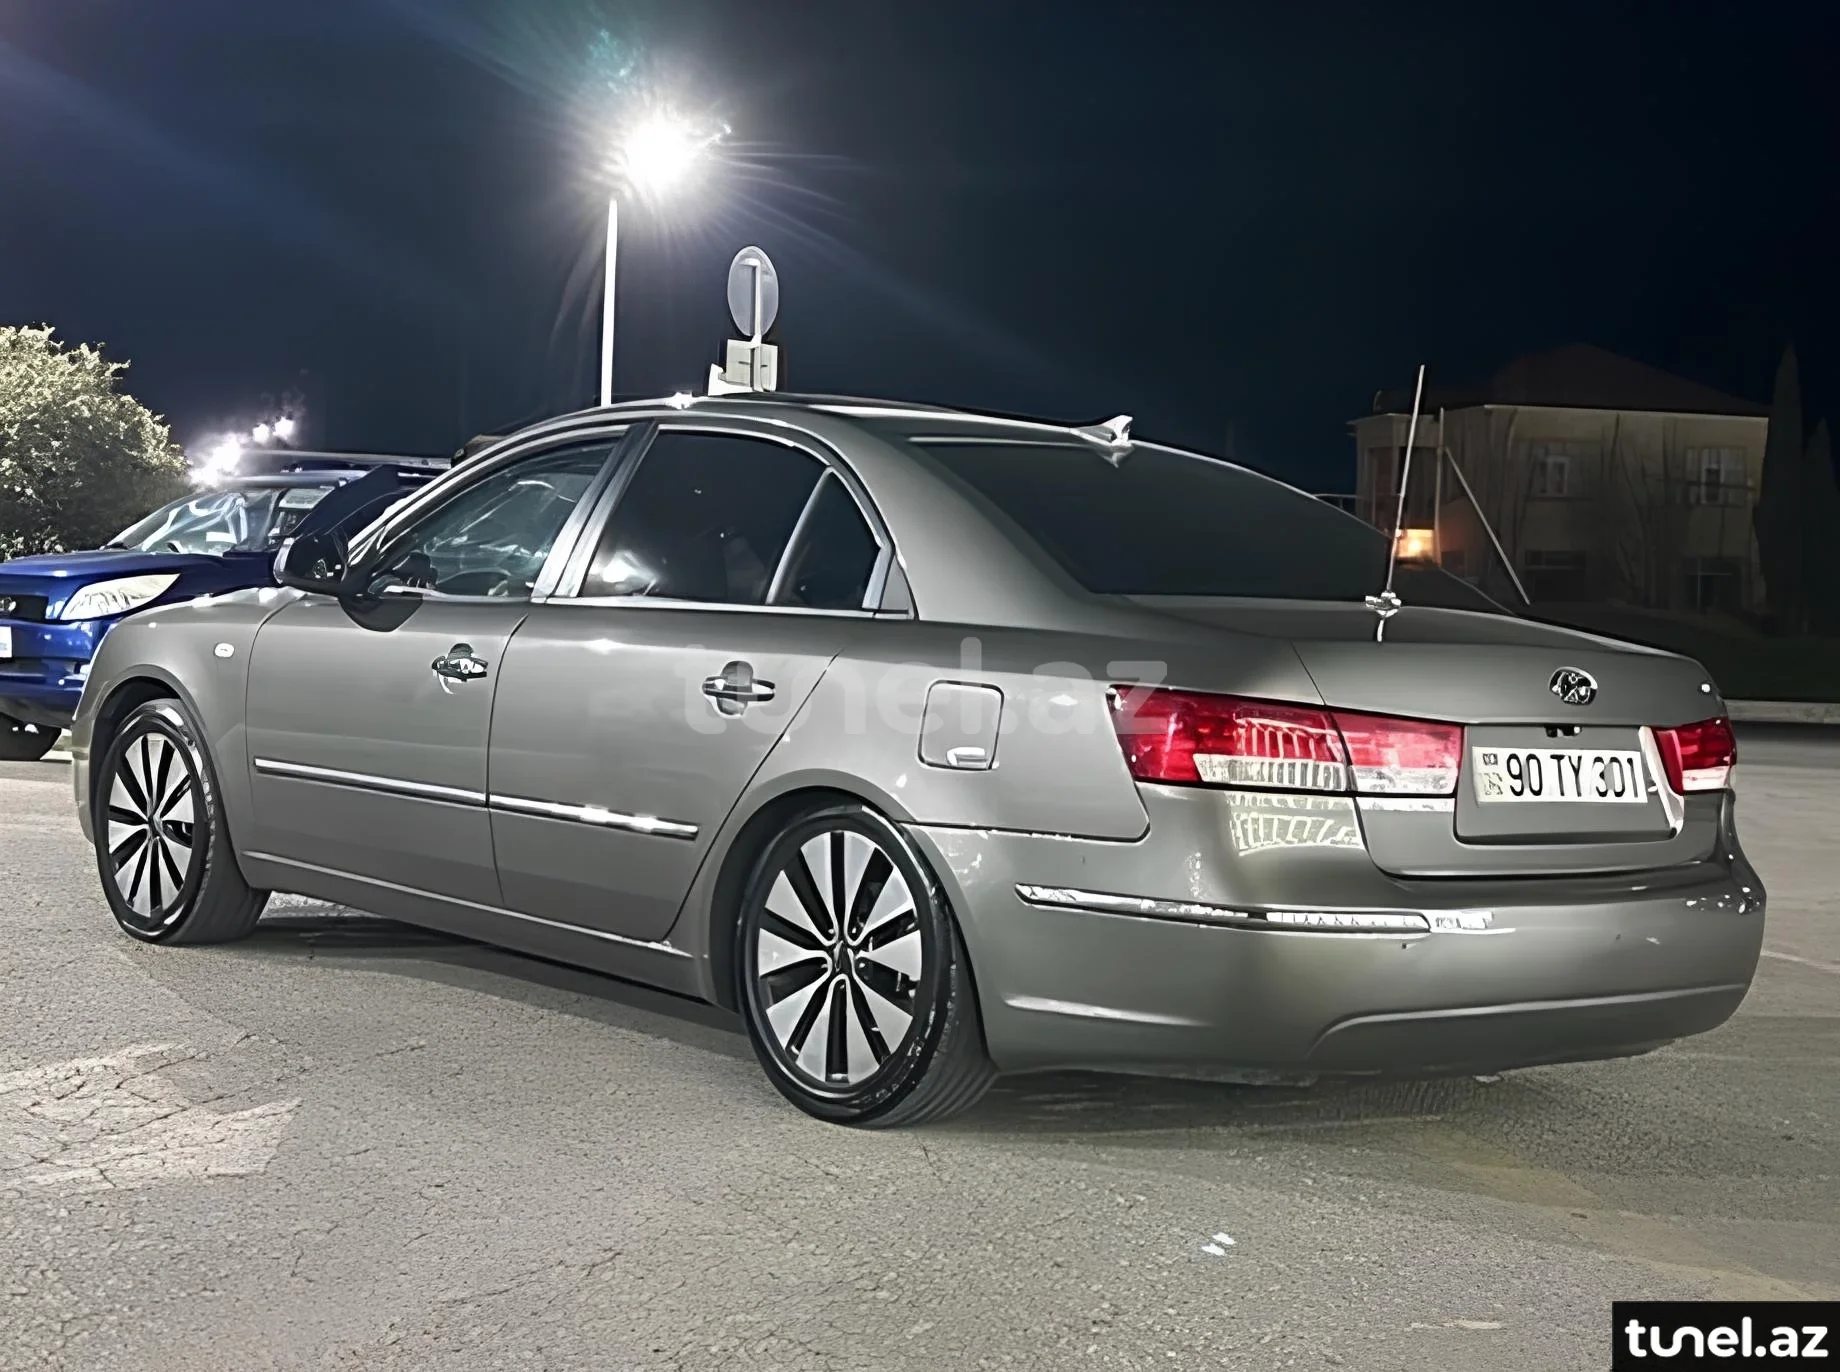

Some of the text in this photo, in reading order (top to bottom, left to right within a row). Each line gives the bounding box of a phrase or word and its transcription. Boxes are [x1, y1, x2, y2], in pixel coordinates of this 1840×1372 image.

[1506, 753, 1543, 796] 90
[1550, 754, 1582, 797] TY
[1592, 756, 1639, 798] 301
